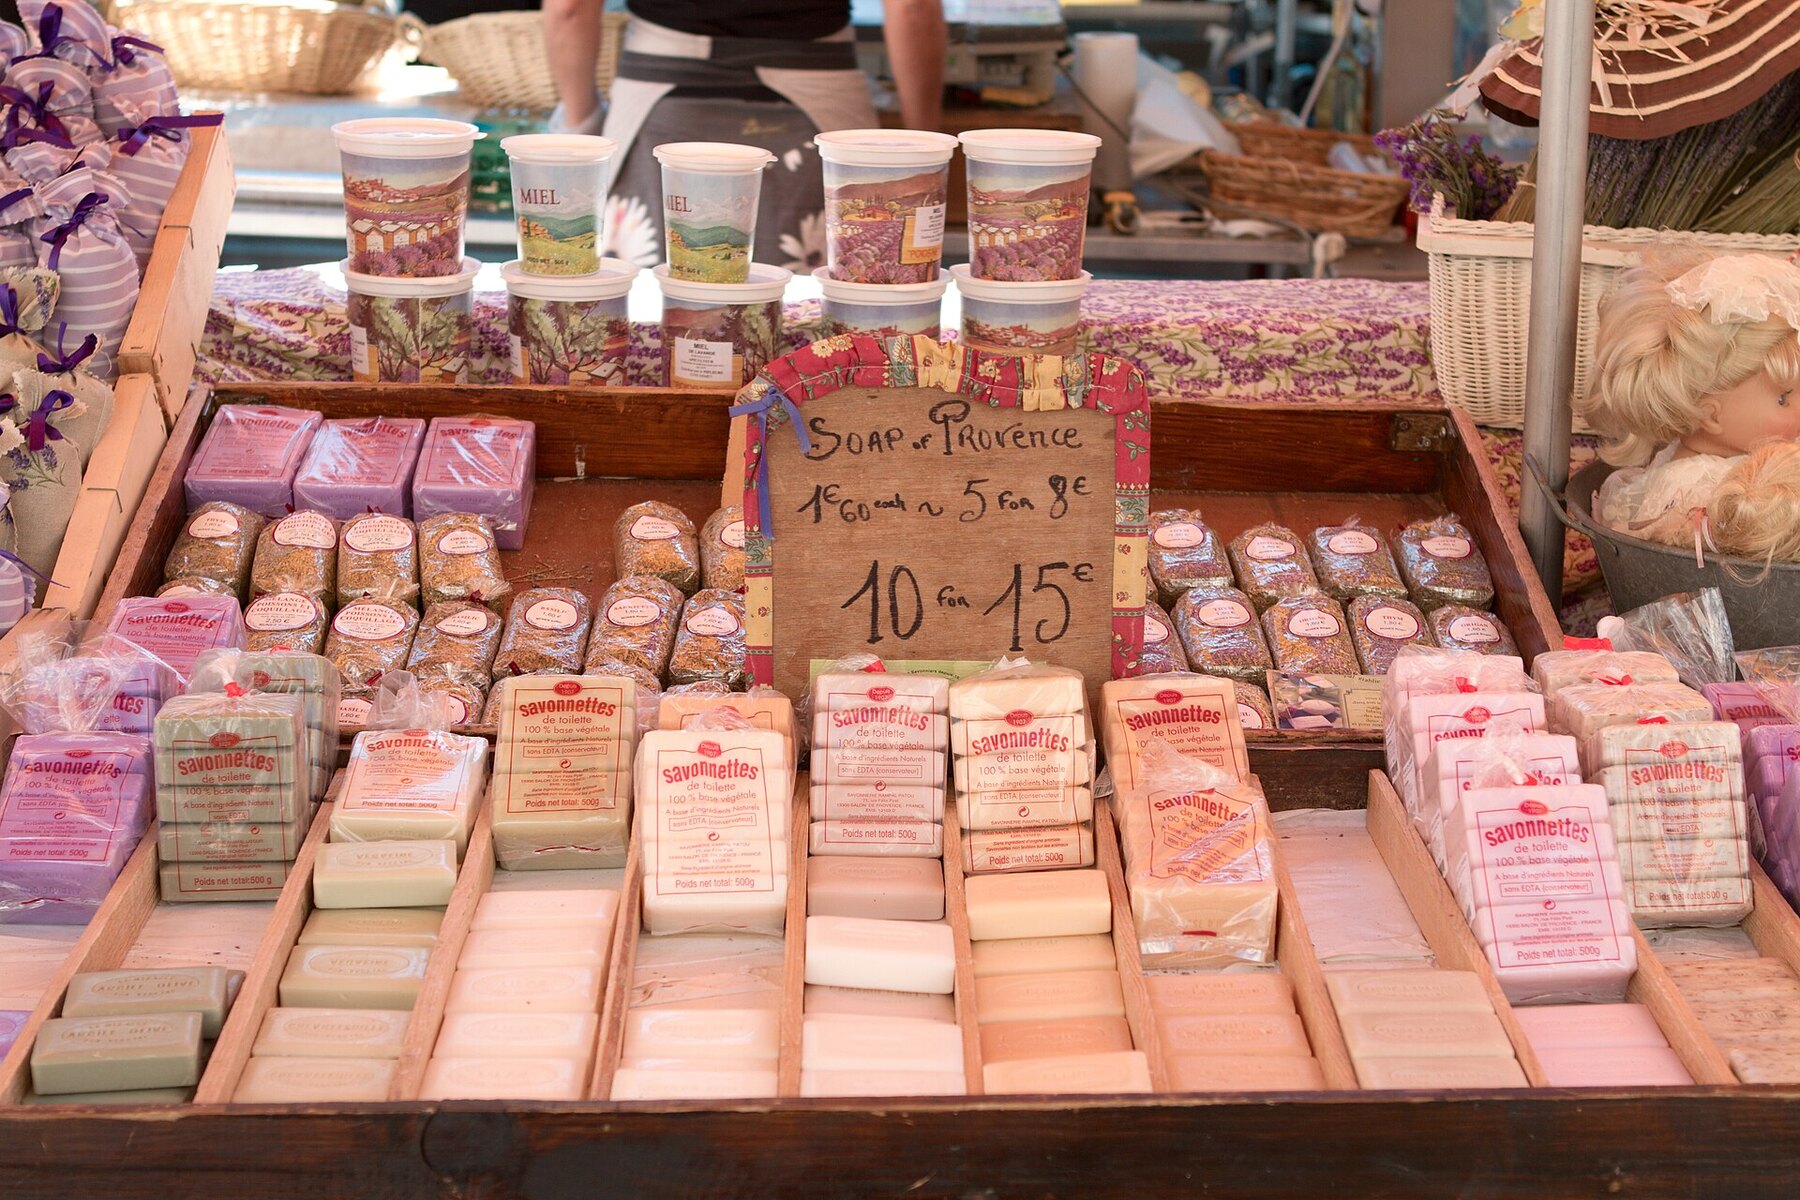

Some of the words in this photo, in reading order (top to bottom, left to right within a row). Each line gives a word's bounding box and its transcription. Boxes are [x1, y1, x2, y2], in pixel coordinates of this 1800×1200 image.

[520, 188, 560, 205] MIEL
[666, 195, 692, 212] IEL
[959, 479, 990, 522] 5
[841, 559, 923, 644] 10
[127, 614, 216, 628] savonnettes
[519, 697, 616, 717] savonnettes
[542, 715, 555, 724] de
[559, 715, 592, 724] toilette
[832, 705, 929, 731] savonnettes
[1126, 705, 1221, 731] savonnettes
[524, 726, 540, 734] 100
[554, 725, 573, 734] base
[576, 724, 610, 734] végétale
[856, 726, 869, 737] de
[873, 726, 905, 738] toilette
[1152, 728, 1164, 736] de
[1168, 725, 1200, 735] toilette
[972, 727, 1069, 756] savonnettes
[1186, 734, 1220, 744] végétale
[838, 739, 854, 748] 100
[867, 740, 888, 750] base
[890, 742, 924, 752] végétale
[178, 749, 275, 775] savonnettes
[996, 752, 1010, 763] de
[1013, 751, 1047, 762] toilette
[24, 760, 121, 778] savonnettes
[662, 758, 759, 784] savonnettes
[979, 766, 996, 776] 100
[997, 766, 1005, 775] %
[1009, 765, 1028, 774] base
[1031, 764, 1065, 776] végétale
[1631, 760, 1724, 786] savonnettes
[45, 775, 58, 783] de
[62, 778, 96, 786] toilette
[202, 774, 214, 783] de
[218, 772, 251, 782] toilette
[55, 785, 75, 793] base
[214, 787, 233, 795] base
[687, 781, 700, 791] de
[703, 781, 736, 791] toilette
[1668, 783, 1702, 793] toilette
[669, 795, 685, 804] 100
[688, 793, 696, 803] %
[699, 792, 718, 803] base
[720, 791, 757, 804] végétale
[999, 792, 1017, 800] EDTA
[581, 799, 599, 807] 500g
[1154, 794, 1248, 822] savonnettes
[689, 817, 707, 825] EDTA
[1485, 818, 1589, 846] savonnettes
[1681, 824, 1699, 832] EDTA
[842, 829, 863, 838] Poids
[865, 830, 877, 838] net
[878, 829, 896, 838] total:
[898, 829, 917, 840] 500g
[69, 849, 88, 857] 500g
[1514, 842, 1529, 853] de
[1532, 841, 1568, 852] toilette
[989, 855, 1010, 865] Poids
[1011, 855, 1023, 863] net
[1025, 854, 1043, 863] total:
[1044, 852, 1064, 863] 500g
[1495, 857, 1514, 867] 100
[1517, 857, 1527, 865] %
[1529, 856, 1550, 865] base
[1554, 855, 1589, 865] végétale
[194, 877, 215, 885] Poids
[675, 879, 697, 888] Poids
[699, 879, 712, 888] net
[714, 879, 732, 887] total:
[735, 877, 755, 888] 500g
[1522, 885, 1540, 893] EDTA
[1517, 951, 1540, 960] Poids
[1543, 950, 1556, 958] net
[1557, 949, 1576, 957] total:
[1579, 947, 1600, 956] 500g
